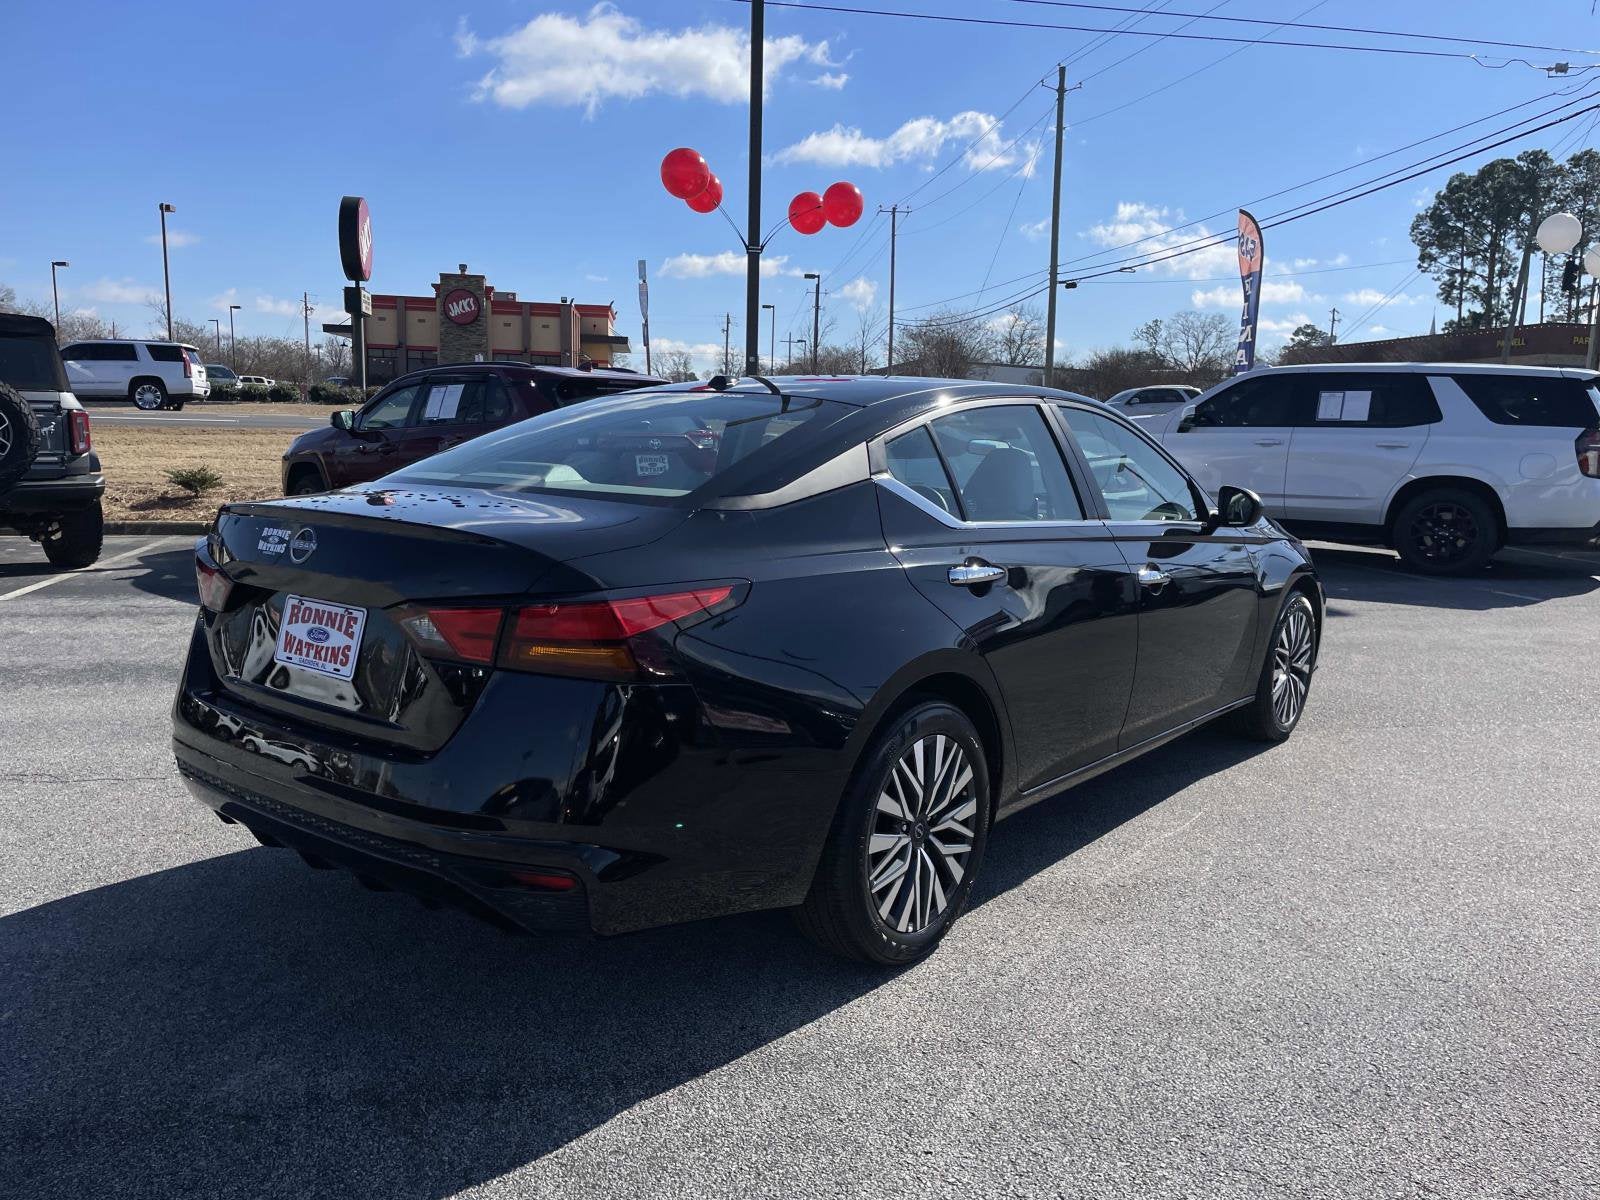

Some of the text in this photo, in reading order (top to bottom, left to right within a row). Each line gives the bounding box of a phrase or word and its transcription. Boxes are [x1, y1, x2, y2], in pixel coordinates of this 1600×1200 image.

[262, 527, 292, 541] RONNIE
[257, 539, 287, 554] WATKINS
[288, 604, 358, 640] RONNIE
[310, 628, 328, 641] Ford
[283, 630, 352, 667] WATKINS
